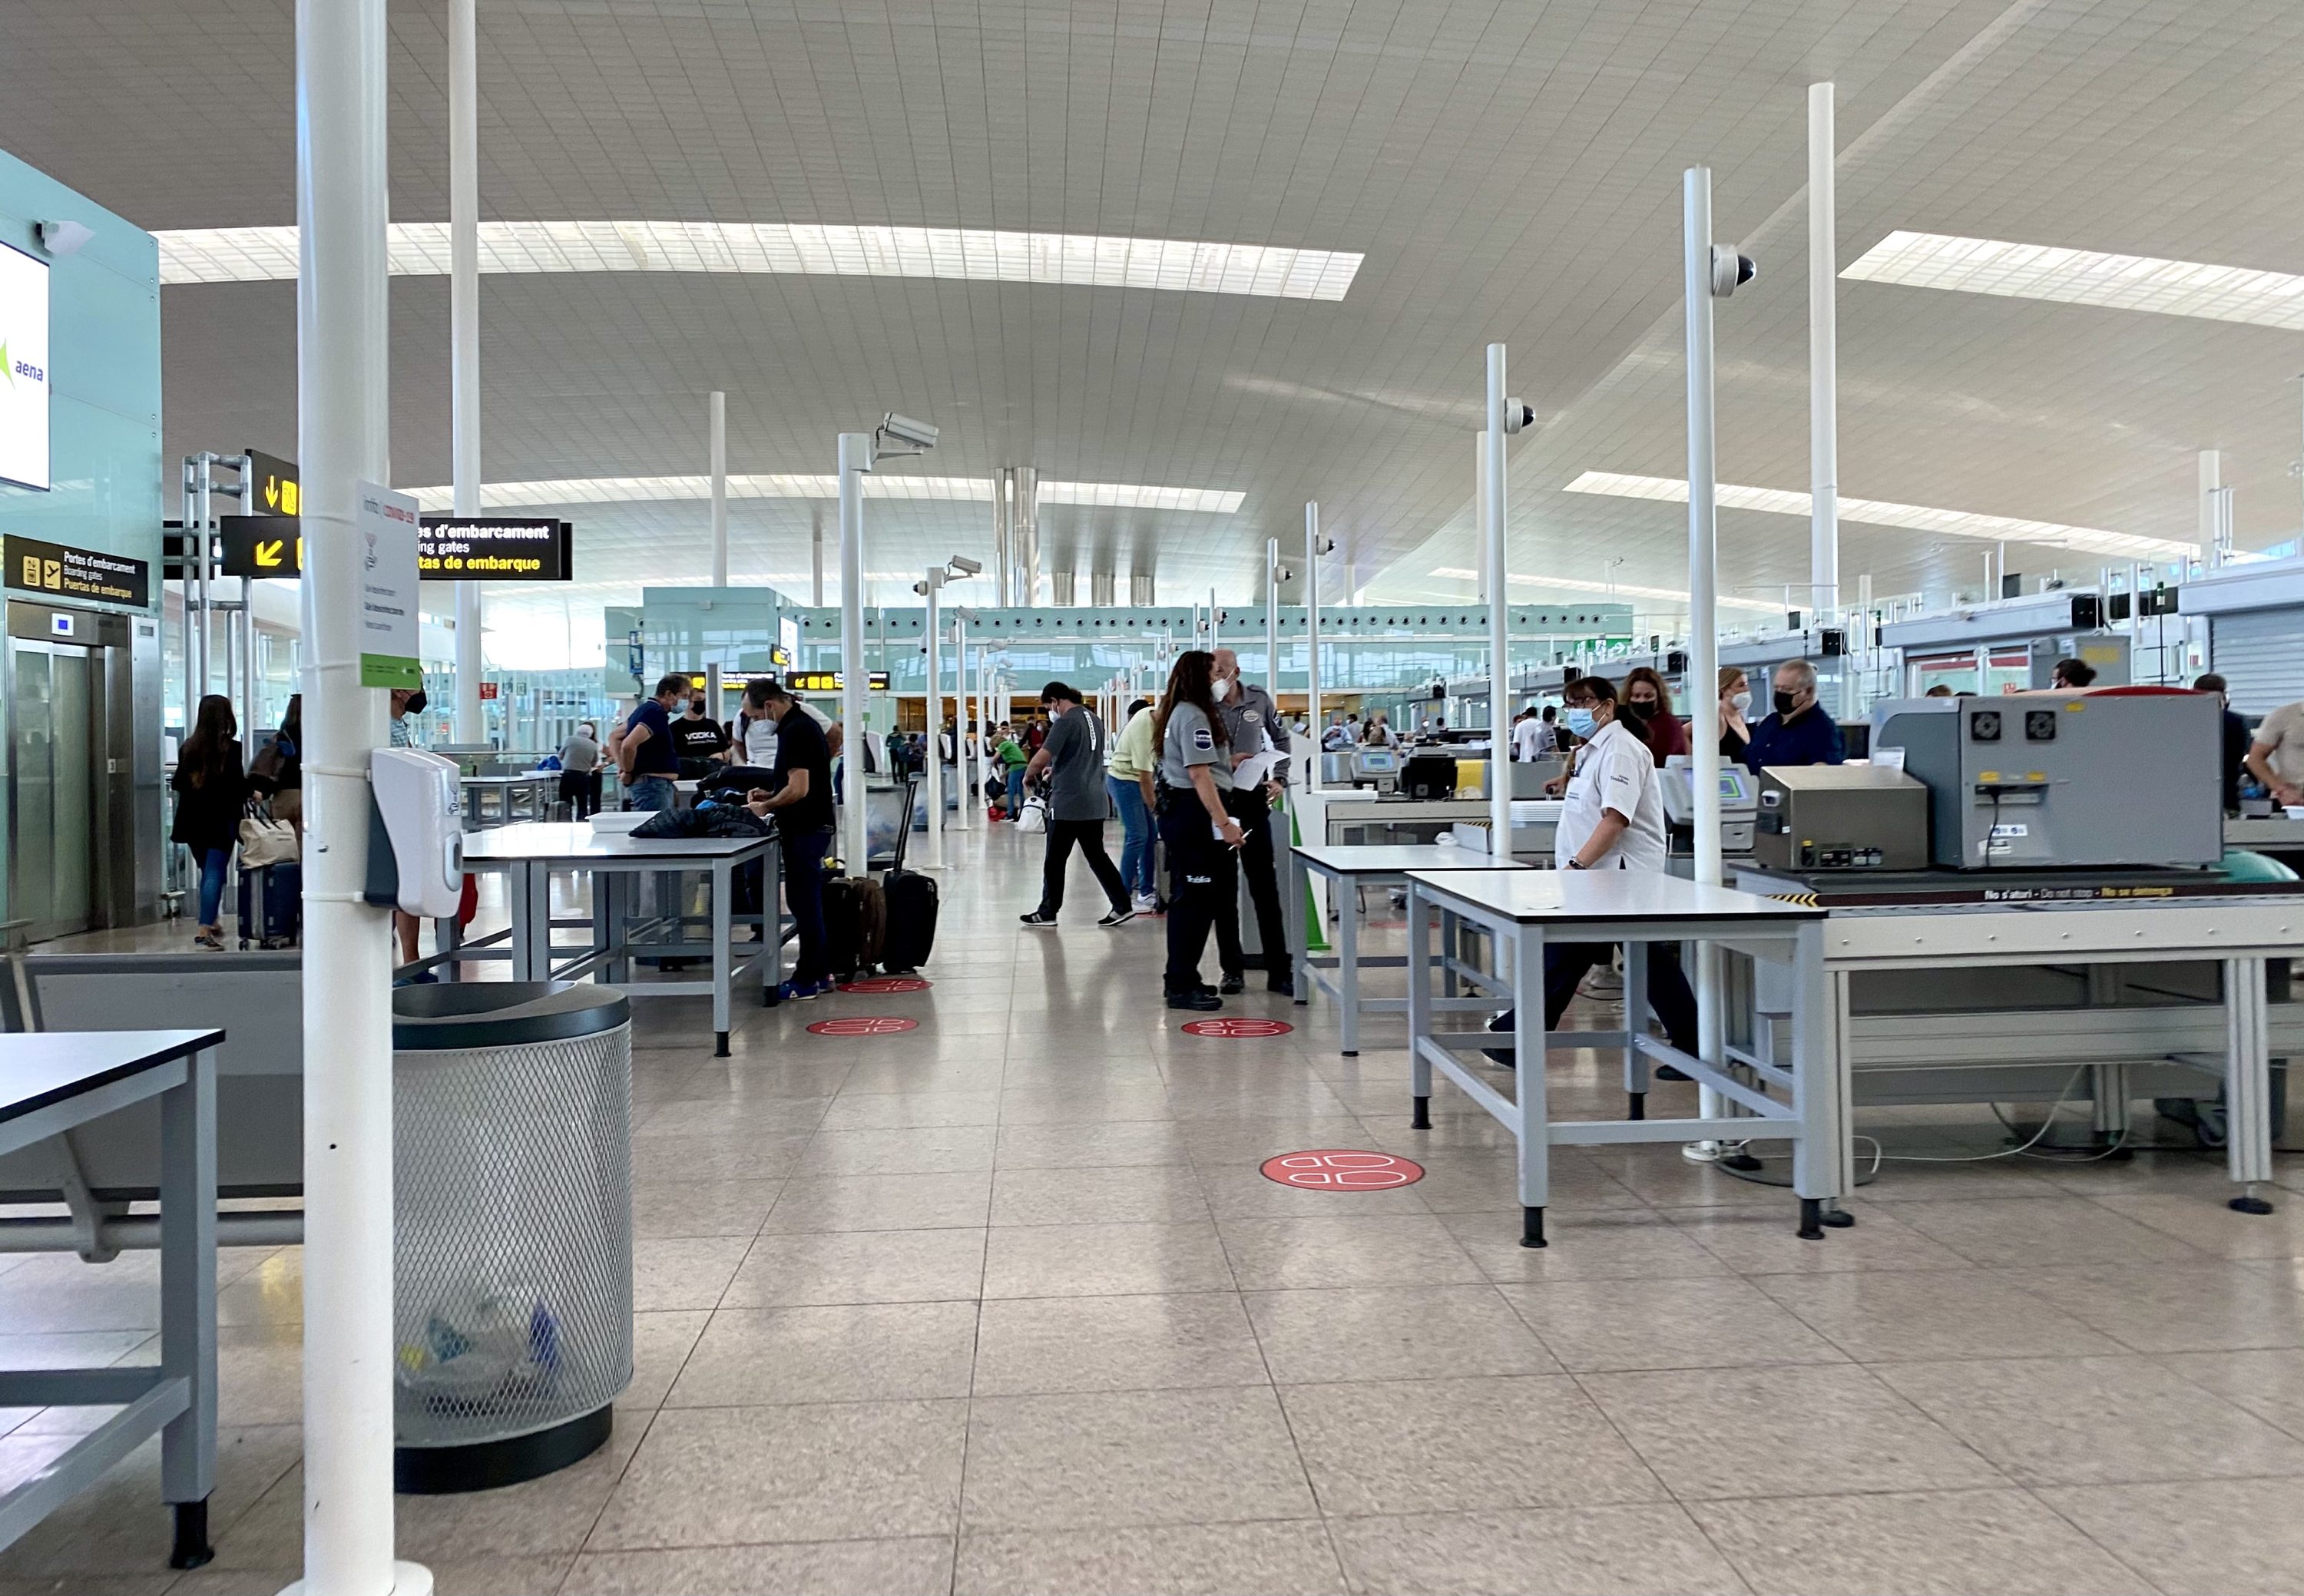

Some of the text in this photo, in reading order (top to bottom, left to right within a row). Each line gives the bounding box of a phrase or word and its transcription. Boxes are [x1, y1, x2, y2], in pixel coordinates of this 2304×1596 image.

[15, 360, 43, 382] aena
[435, 524, 550, 540] d'embarcament
[438, 542, 470, 555] gates
[64, 551, 86, 566] Portes
[444, 555, 462, 570] de
[466, 556, 541, 573] embarque
[64, 578, 91, 593] Puertas
[91, 582, 100, 594] de
[684, 731, 717, 740] VODKA
[1985, 889, 2000, 900] No
[2041, 888, 2054, 899] Do
[2101, 887, 2116, 897] No
